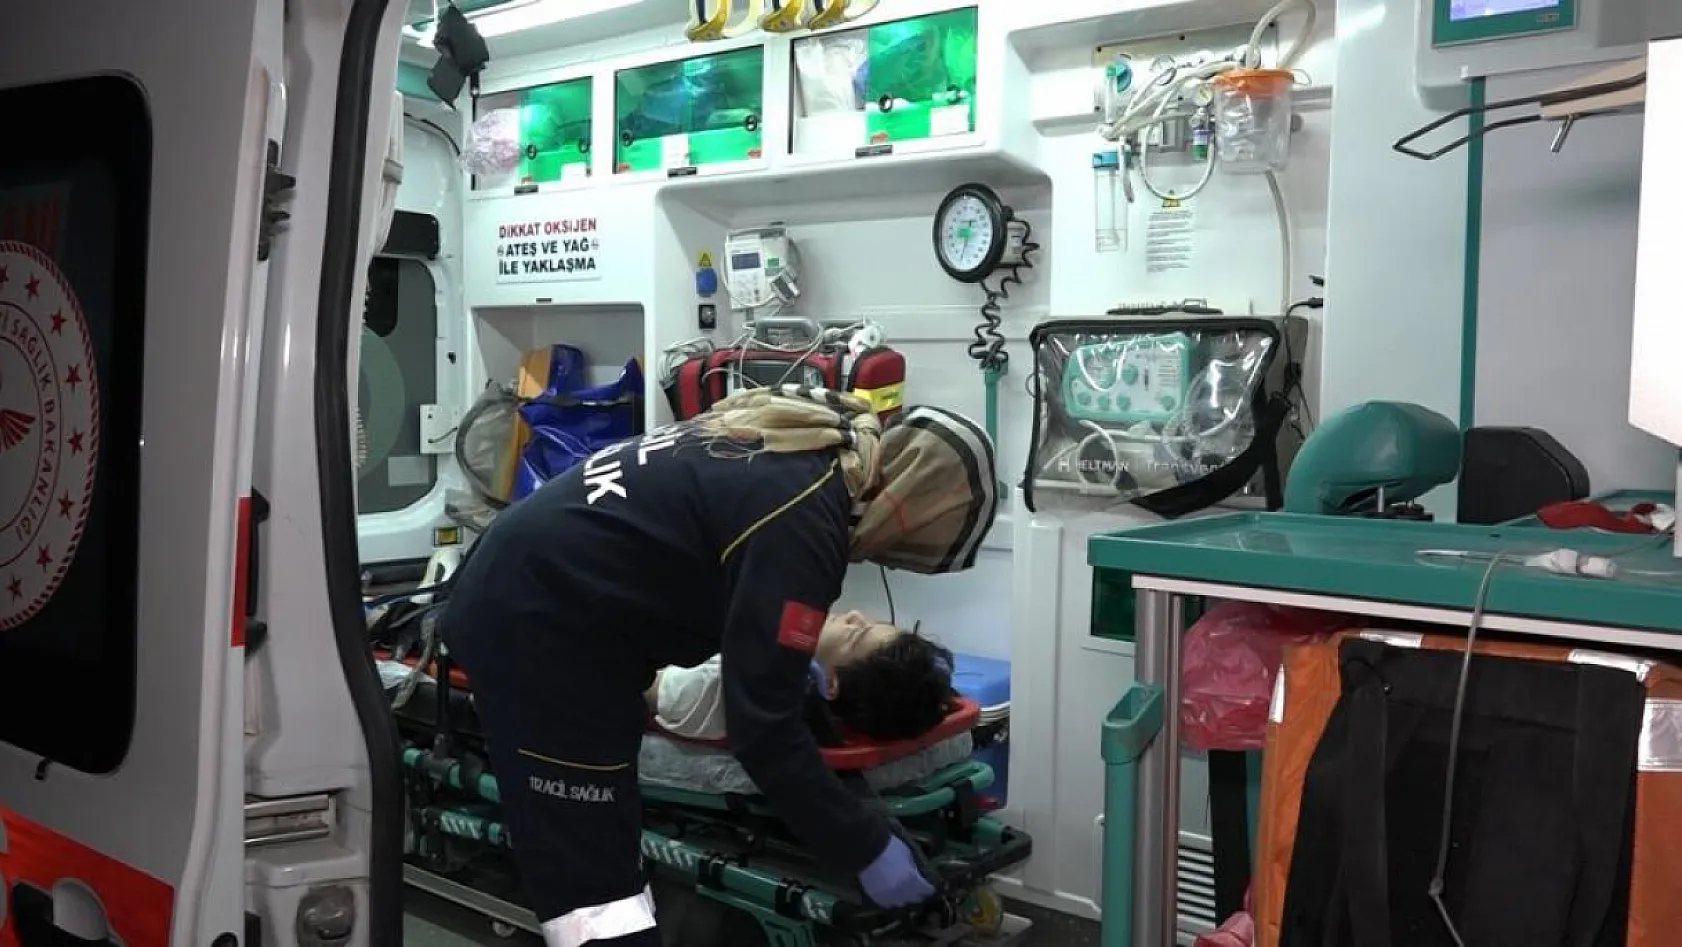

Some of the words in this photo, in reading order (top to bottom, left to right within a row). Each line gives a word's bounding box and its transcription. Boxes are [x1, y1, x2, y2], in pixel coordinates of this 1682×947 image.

[505, 242, 537, 257] ATEŞ
[541, 240, 558, 254] VE
[563, 236, 590, 252] YAĞ
[499, 258, 519, 275] İLE
[522, 257, 596, 273] YAKLAŞMA
